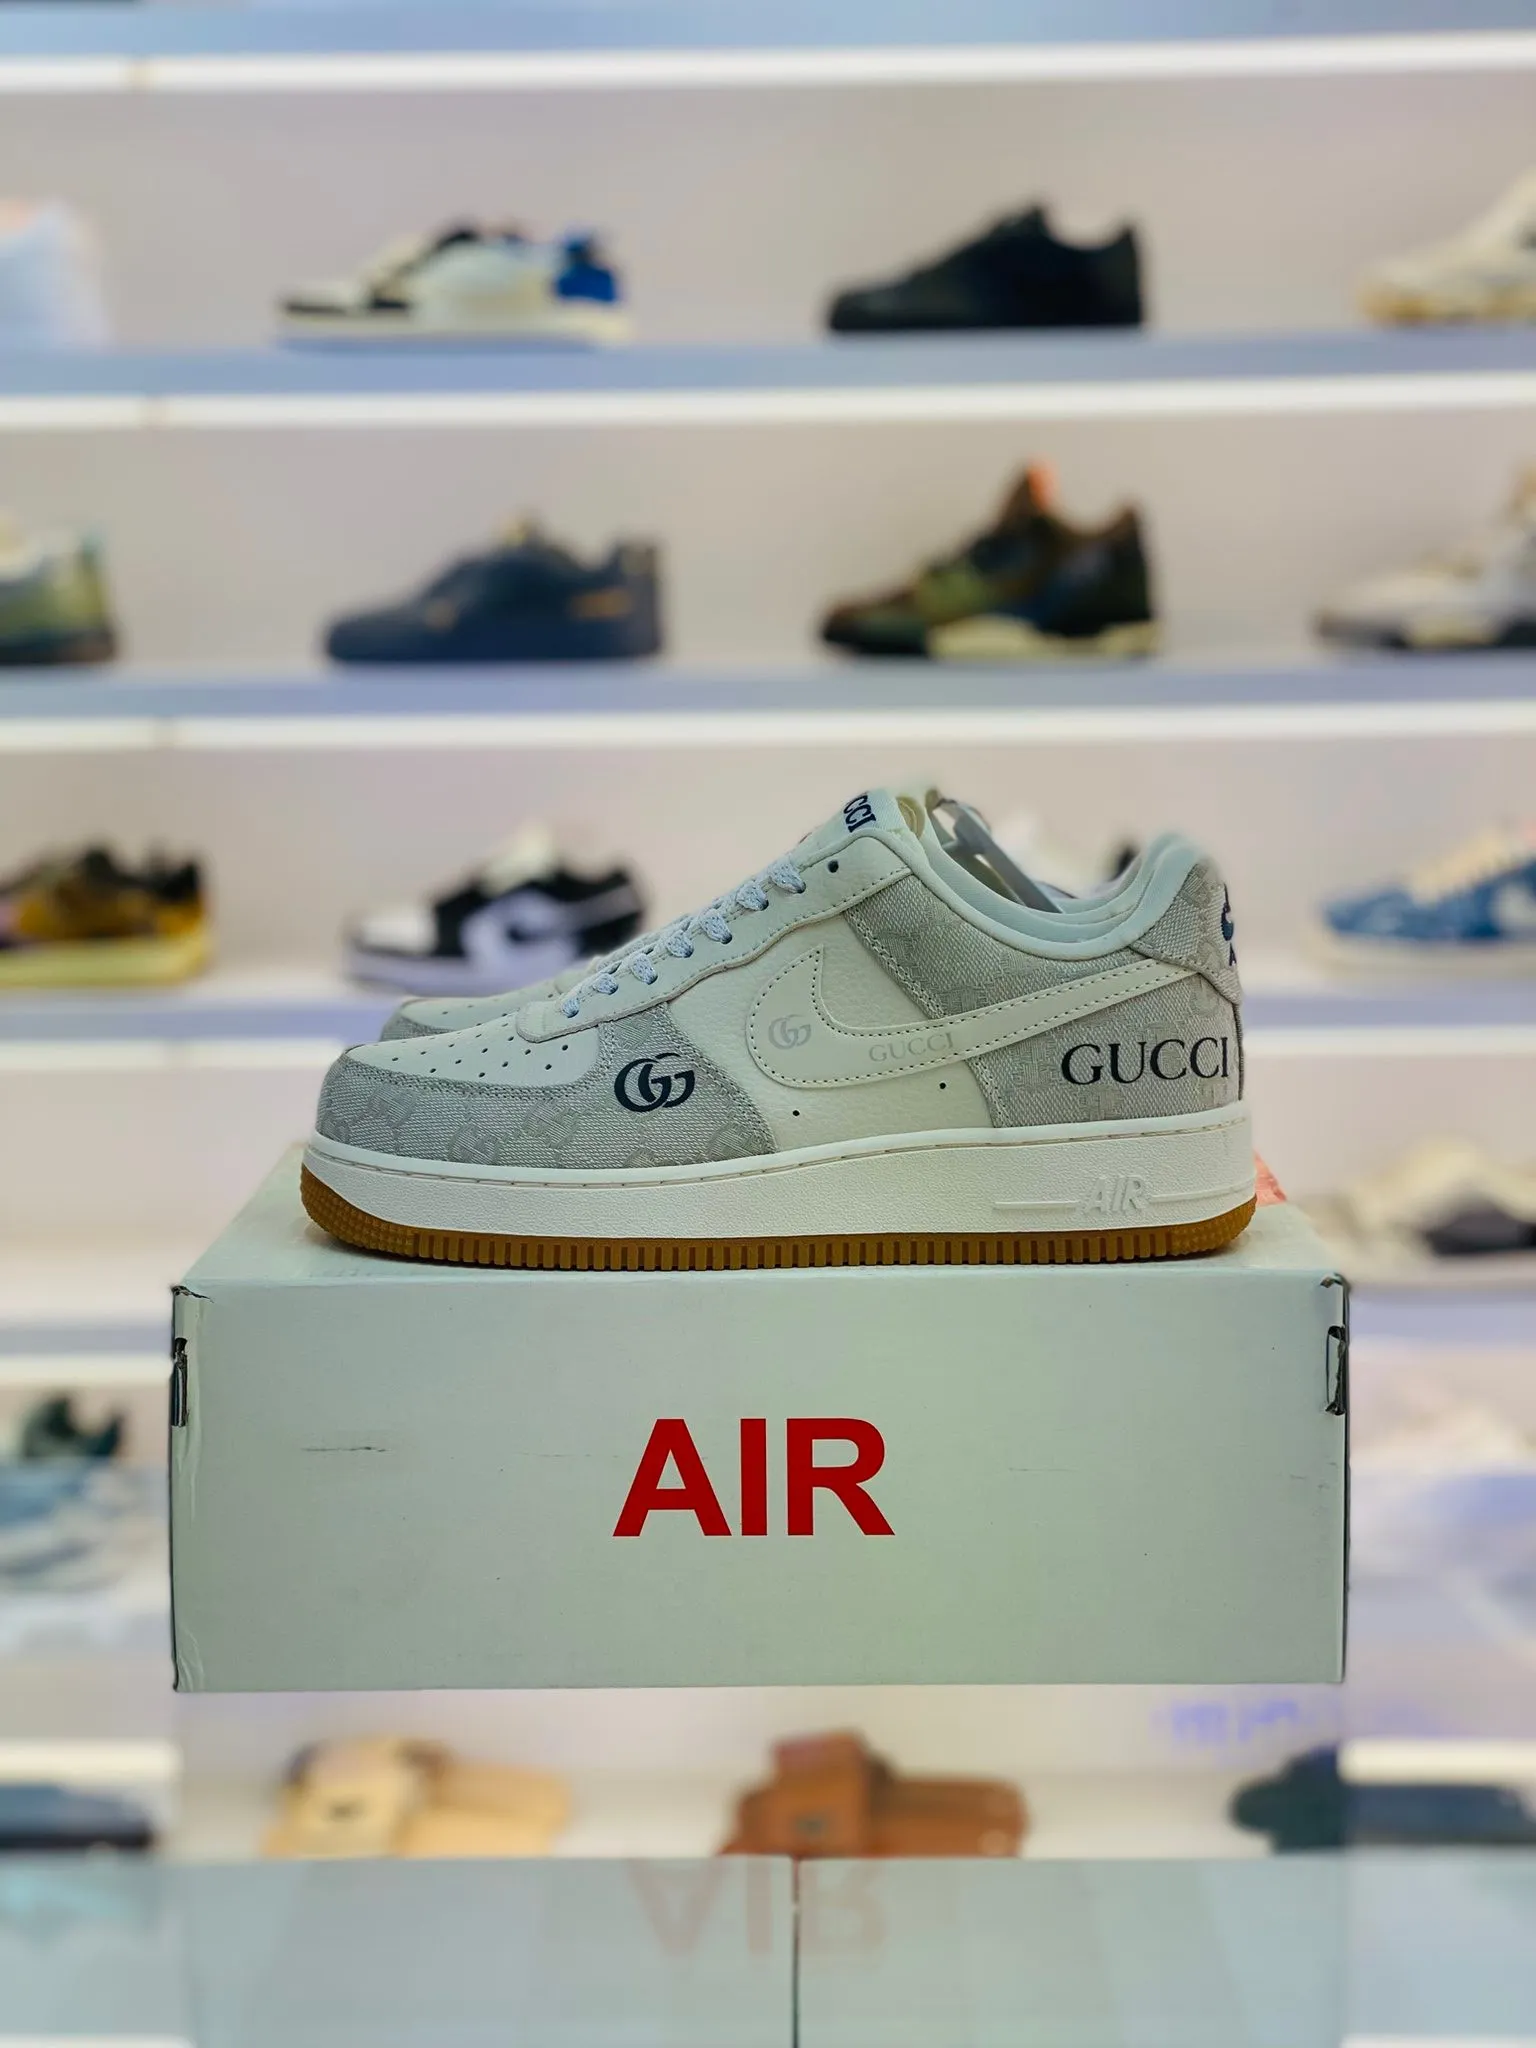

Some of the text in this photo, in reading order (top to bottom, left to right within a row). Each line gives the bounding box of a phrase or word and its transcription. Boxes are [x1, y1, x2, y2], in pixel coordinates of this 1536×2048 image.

[843, 791, 877, 833] CCI
[868, 1032, 954, 1062] GUCCI
[1061, 1036, 1229, 1085] GUCCI
[1083, 1176, 1147, 1216] AIR
[612, 1417, 894, 1537] AIR
